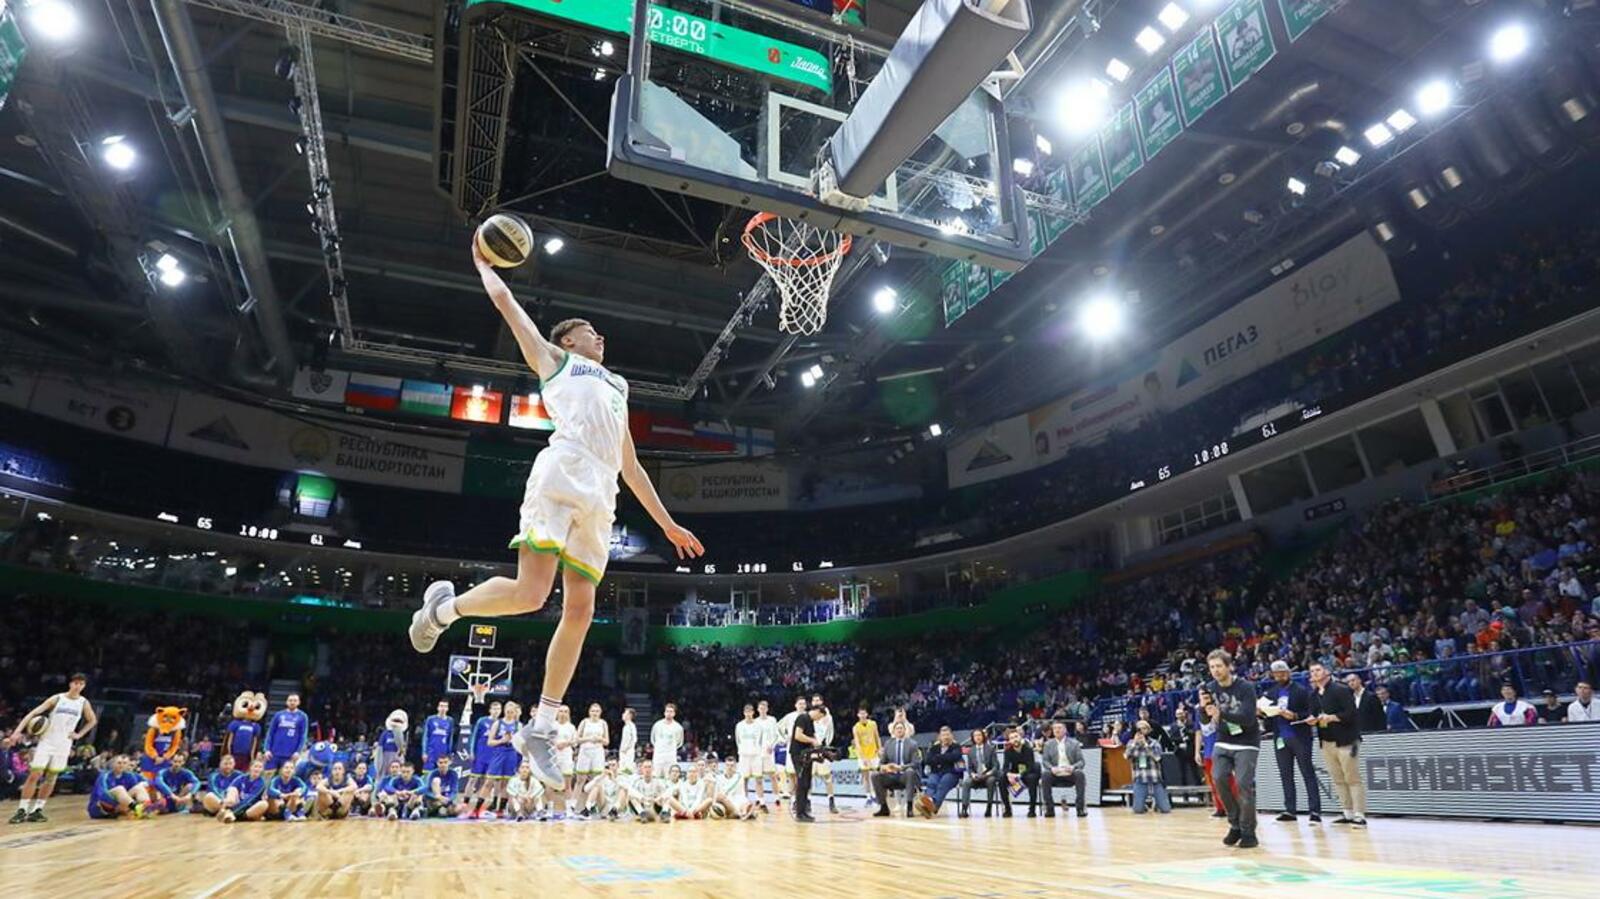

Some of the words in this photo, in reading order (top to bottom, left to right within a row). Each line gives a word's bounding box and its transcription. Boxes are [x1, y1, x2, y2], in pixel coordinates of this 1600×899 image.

[649, 8, 706, 41] 0:00
[651, 32, 705, 54] ЕТВЕРТЬ
[1204, 325, 1259, 366] ПЕГАЗ
[340, 436, 428, 461] РЕСПУБЛИКА
[1158, 465, 1172, 481] 65
[1262, 422, 1278, 439] 61
[336, 452, 446, 480] БАШКОРТОСТАН
[702, 473, 766, 487] РЕСПУБЛИКА
[702, 486, 780, 499] БАШКОРТОСТАН
[197, 516, 213, 530] 65
[310, 533, 325, 547] 61
[704, 564, 717, 575] 65
[792, 561, 804, 572] 61
[1367, 753, 1600, 793] COMBASKET
